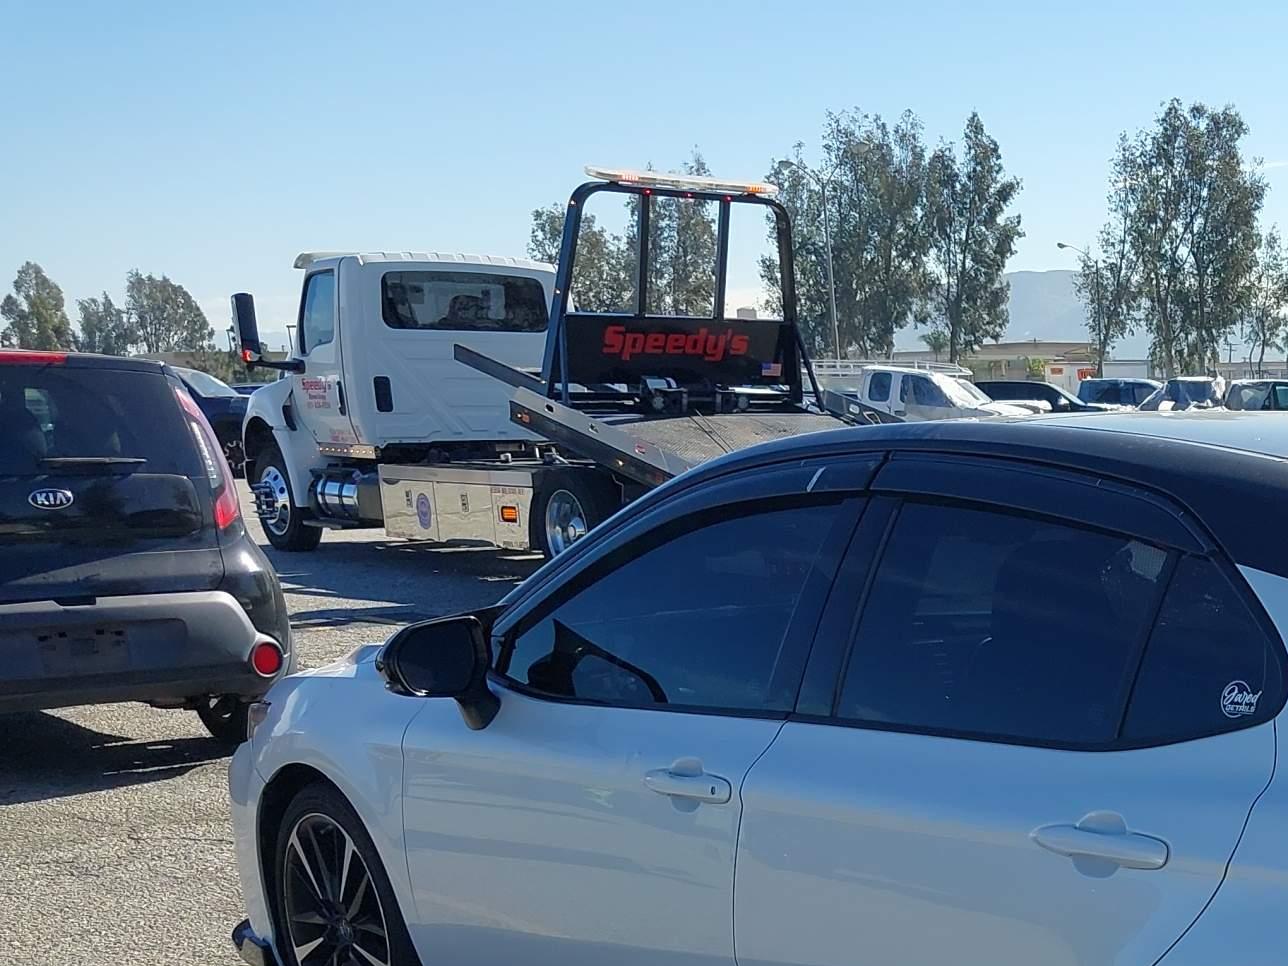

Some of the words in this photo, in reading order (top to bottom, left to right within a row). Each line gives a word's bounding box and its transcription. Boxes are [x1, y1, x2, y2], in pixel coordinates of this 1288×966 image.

[602, 324, 750, 362] Speedy's
[35, 492, 68, 505] KIA
[1223, 685, 1263, 706] Jared
